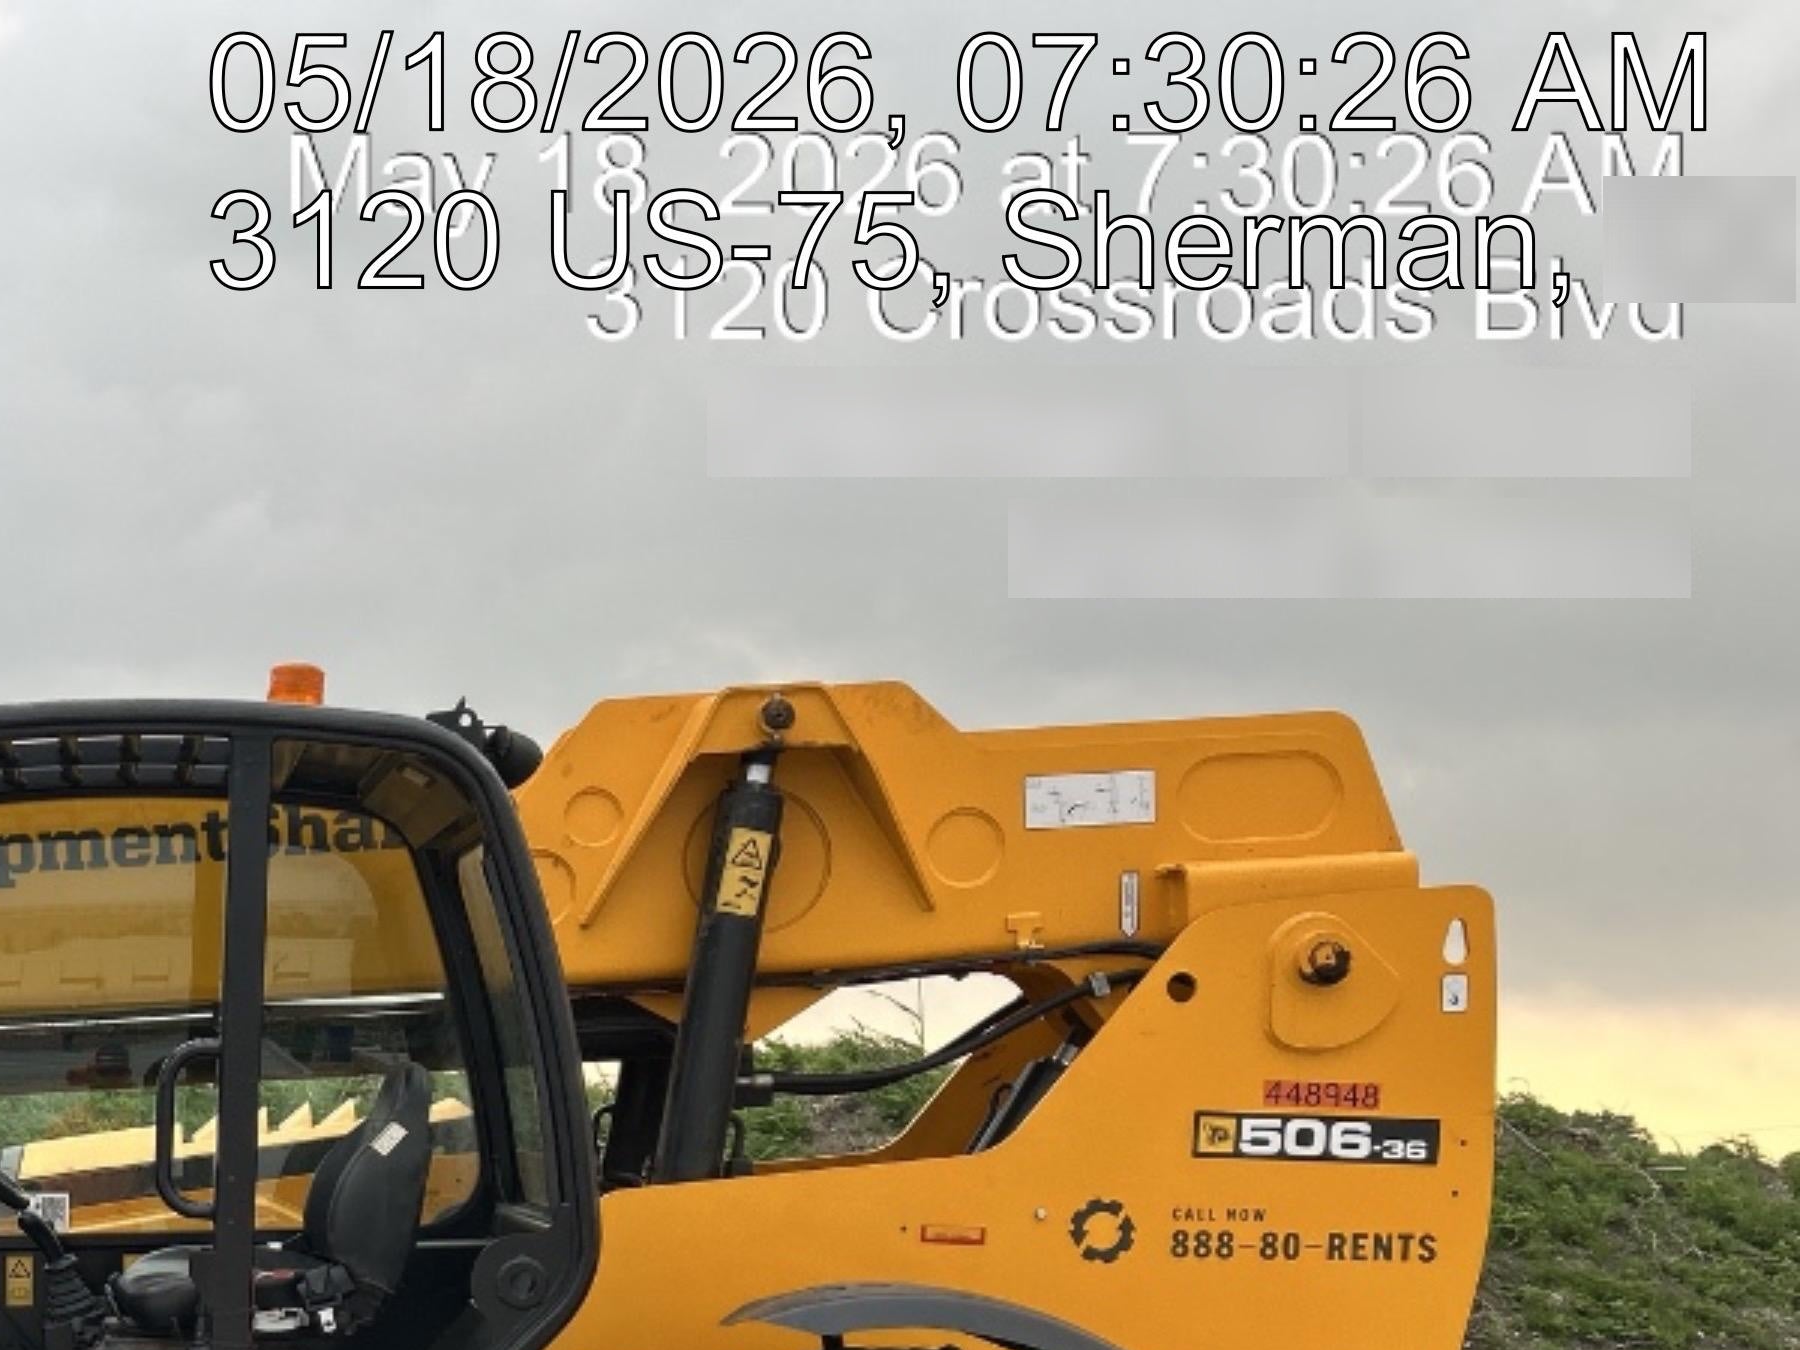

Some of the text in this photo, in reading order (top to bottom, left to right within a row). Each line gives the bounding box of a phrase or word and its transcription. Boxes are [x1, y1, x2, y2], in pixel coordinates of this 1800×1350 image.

[1265, 1080, 1380, 1109] 448948
[1172, 1207, 1216, 1222] CALL
[1170, 1229, 1437, 1263] 888-80-RENTS
